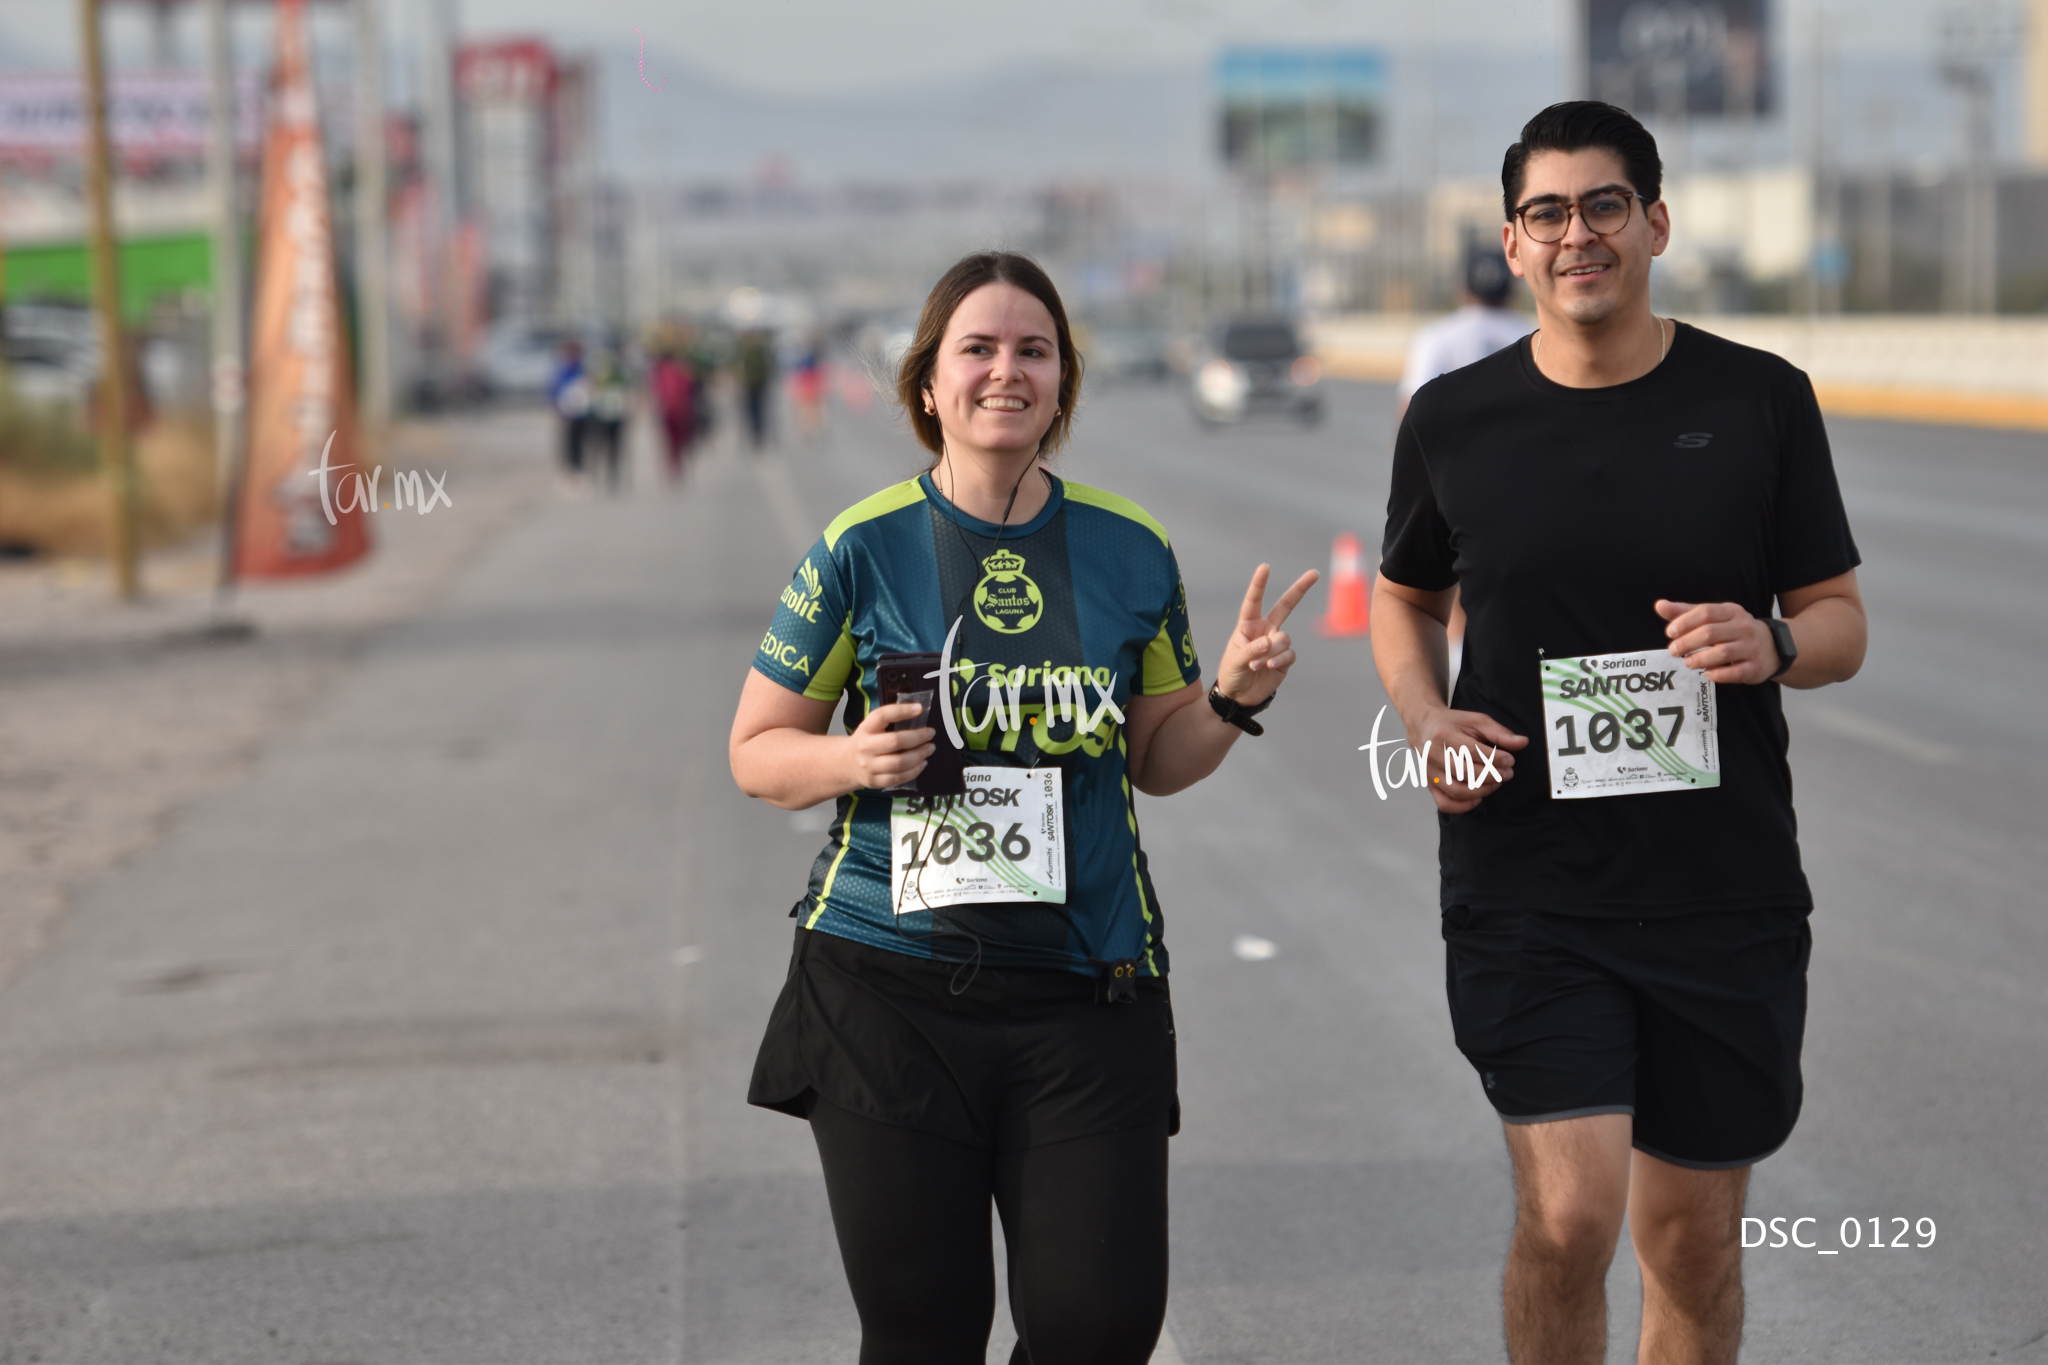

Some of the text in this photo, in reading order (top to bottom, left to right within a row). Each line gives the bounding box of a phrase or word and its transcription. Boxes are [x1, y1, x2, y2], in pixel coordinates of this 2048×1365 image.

[985, 594, 1030, 609] Santos
[986, 660, 1111, 688] Soriana
[1602, 658, 1647, 670] Soriana
[1559, 670, 1677, 699] SANTOSK
[1701, 682, 1709, 722] SANTOSK
[1555, 706, 1685, 757] 1037
[1044, 772, 1053, 799] 1036
[1046, 803, 1055, 842] SANTOSK
[901, 822, 1031, 872] 1036
